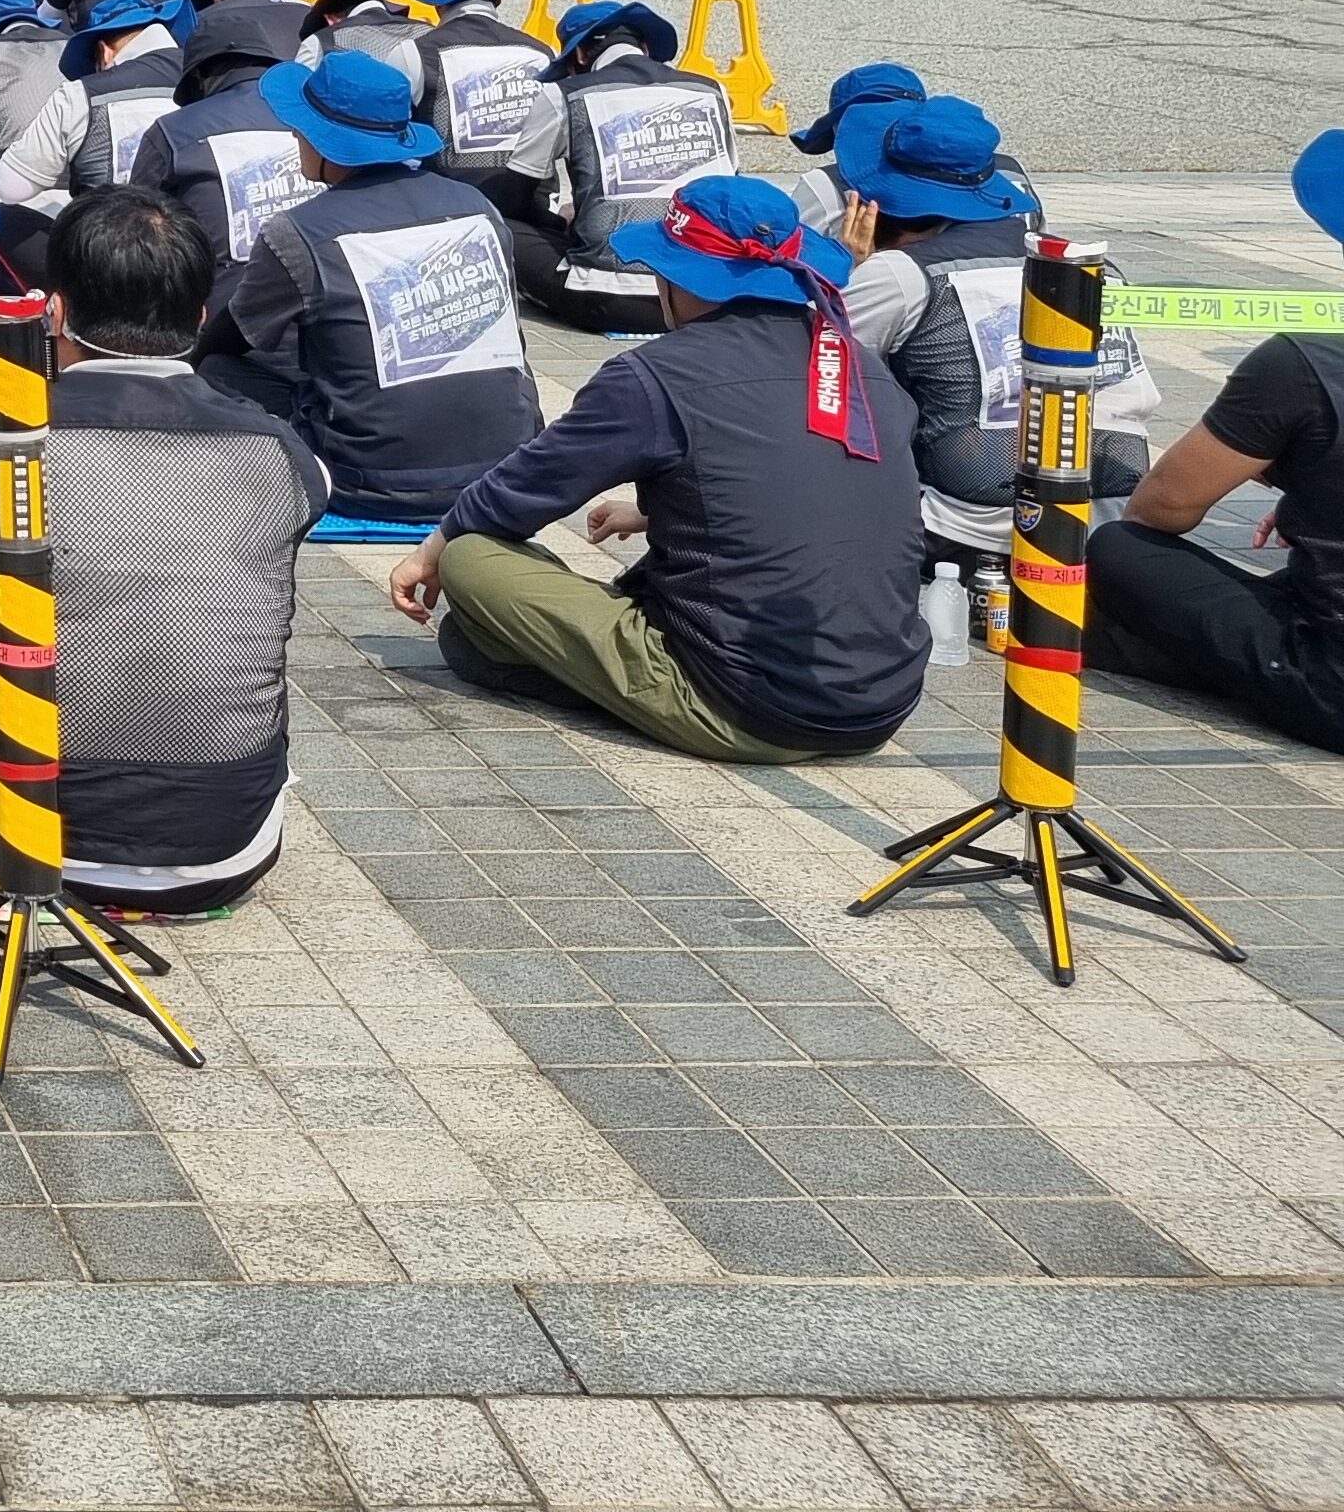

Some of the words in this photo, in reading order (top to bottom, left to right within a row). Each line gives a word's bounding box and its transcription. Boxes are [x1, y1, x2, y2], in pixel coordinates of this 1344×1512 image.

[490, 66, 526, 86] 2026
[467, 83, 504, 107] 함께
[642, 107, 683, 129] 2026
[617, 123, 659, 150] 함께
[660, 120, 712, 144] 싸우자
[246, 175, 290, 204] 함께
[417, 250, 463, 283] 2026
[389, 279, 442, 317] 함께
[440, 260, 496, 295] 싸우자
[400, 317, 422, 333] 모든
[423, 300, 463, 322] 노동자의
[1178, 296, 1222, 320] 함께
[1234, 300, 1303, 323] 지키는
[1016, 563, 1044, 581] 충남
[969, 594, 988, 608] T.O
